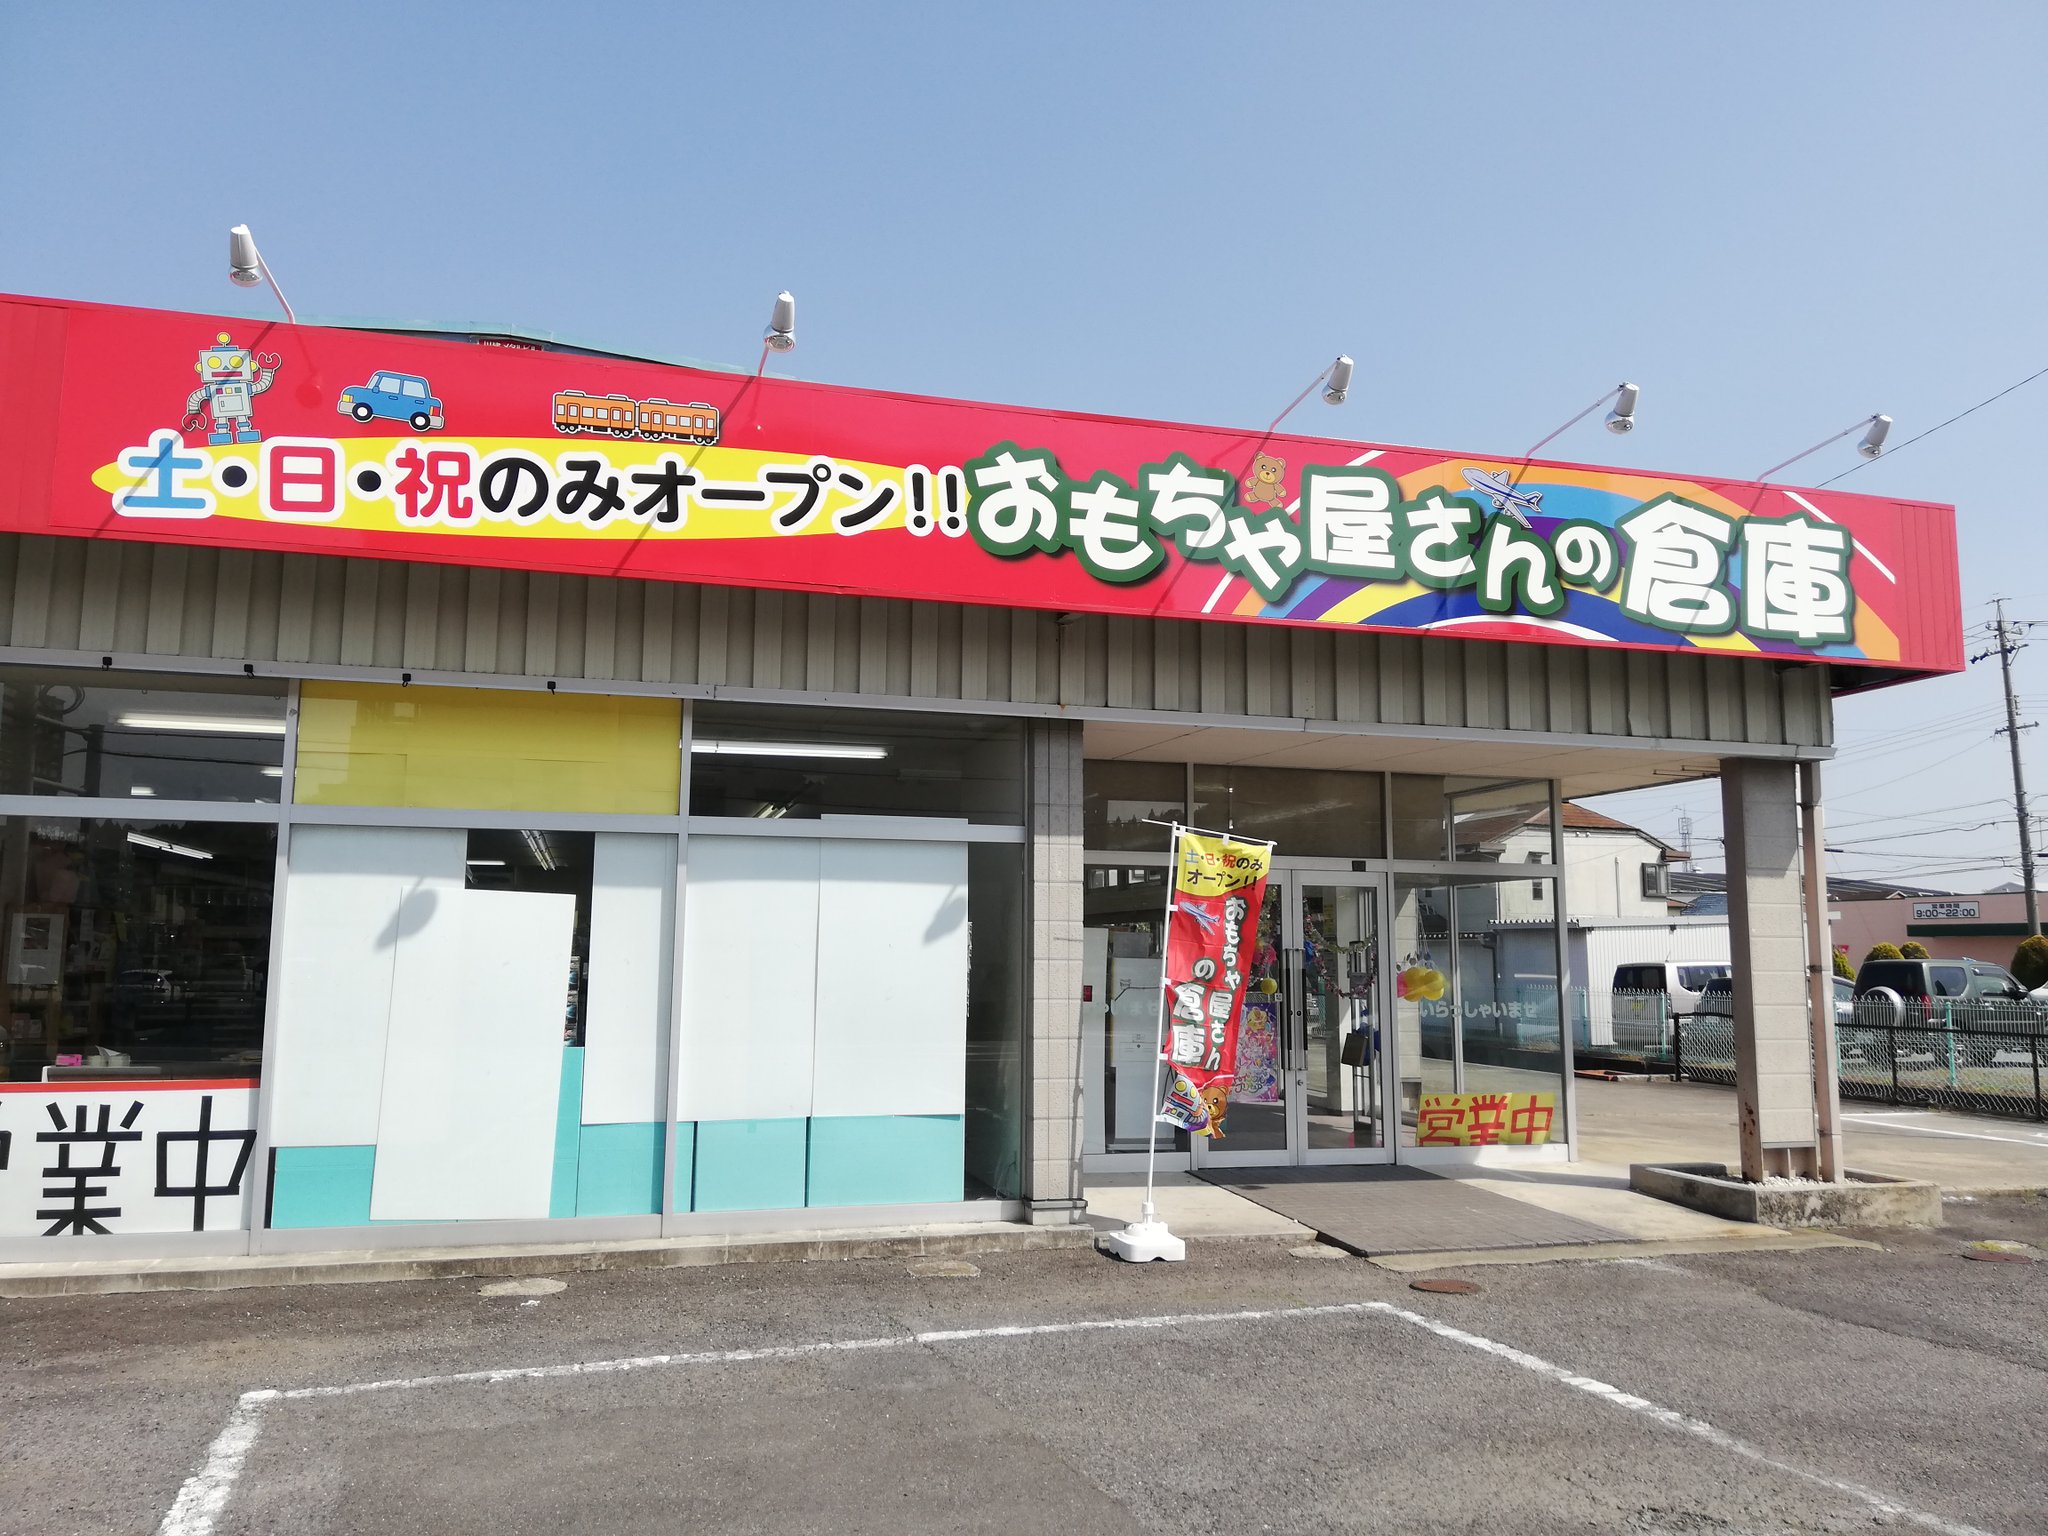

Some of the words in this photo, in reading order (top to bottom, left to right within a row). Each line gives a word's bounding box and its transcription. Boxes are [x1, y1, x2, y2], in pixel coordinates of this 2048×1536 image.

[971, 450, 1848, 640] おもちゃ屋さんの倉庫
[1204, 896, 1247, 1071] おもちゃ屋さん
[1420, 1000, 1539, 1018] いらっしゃいませ
[0, 1095, 258, 1237] 業中
[1418, 1094, 1554, 1147] 営業中
